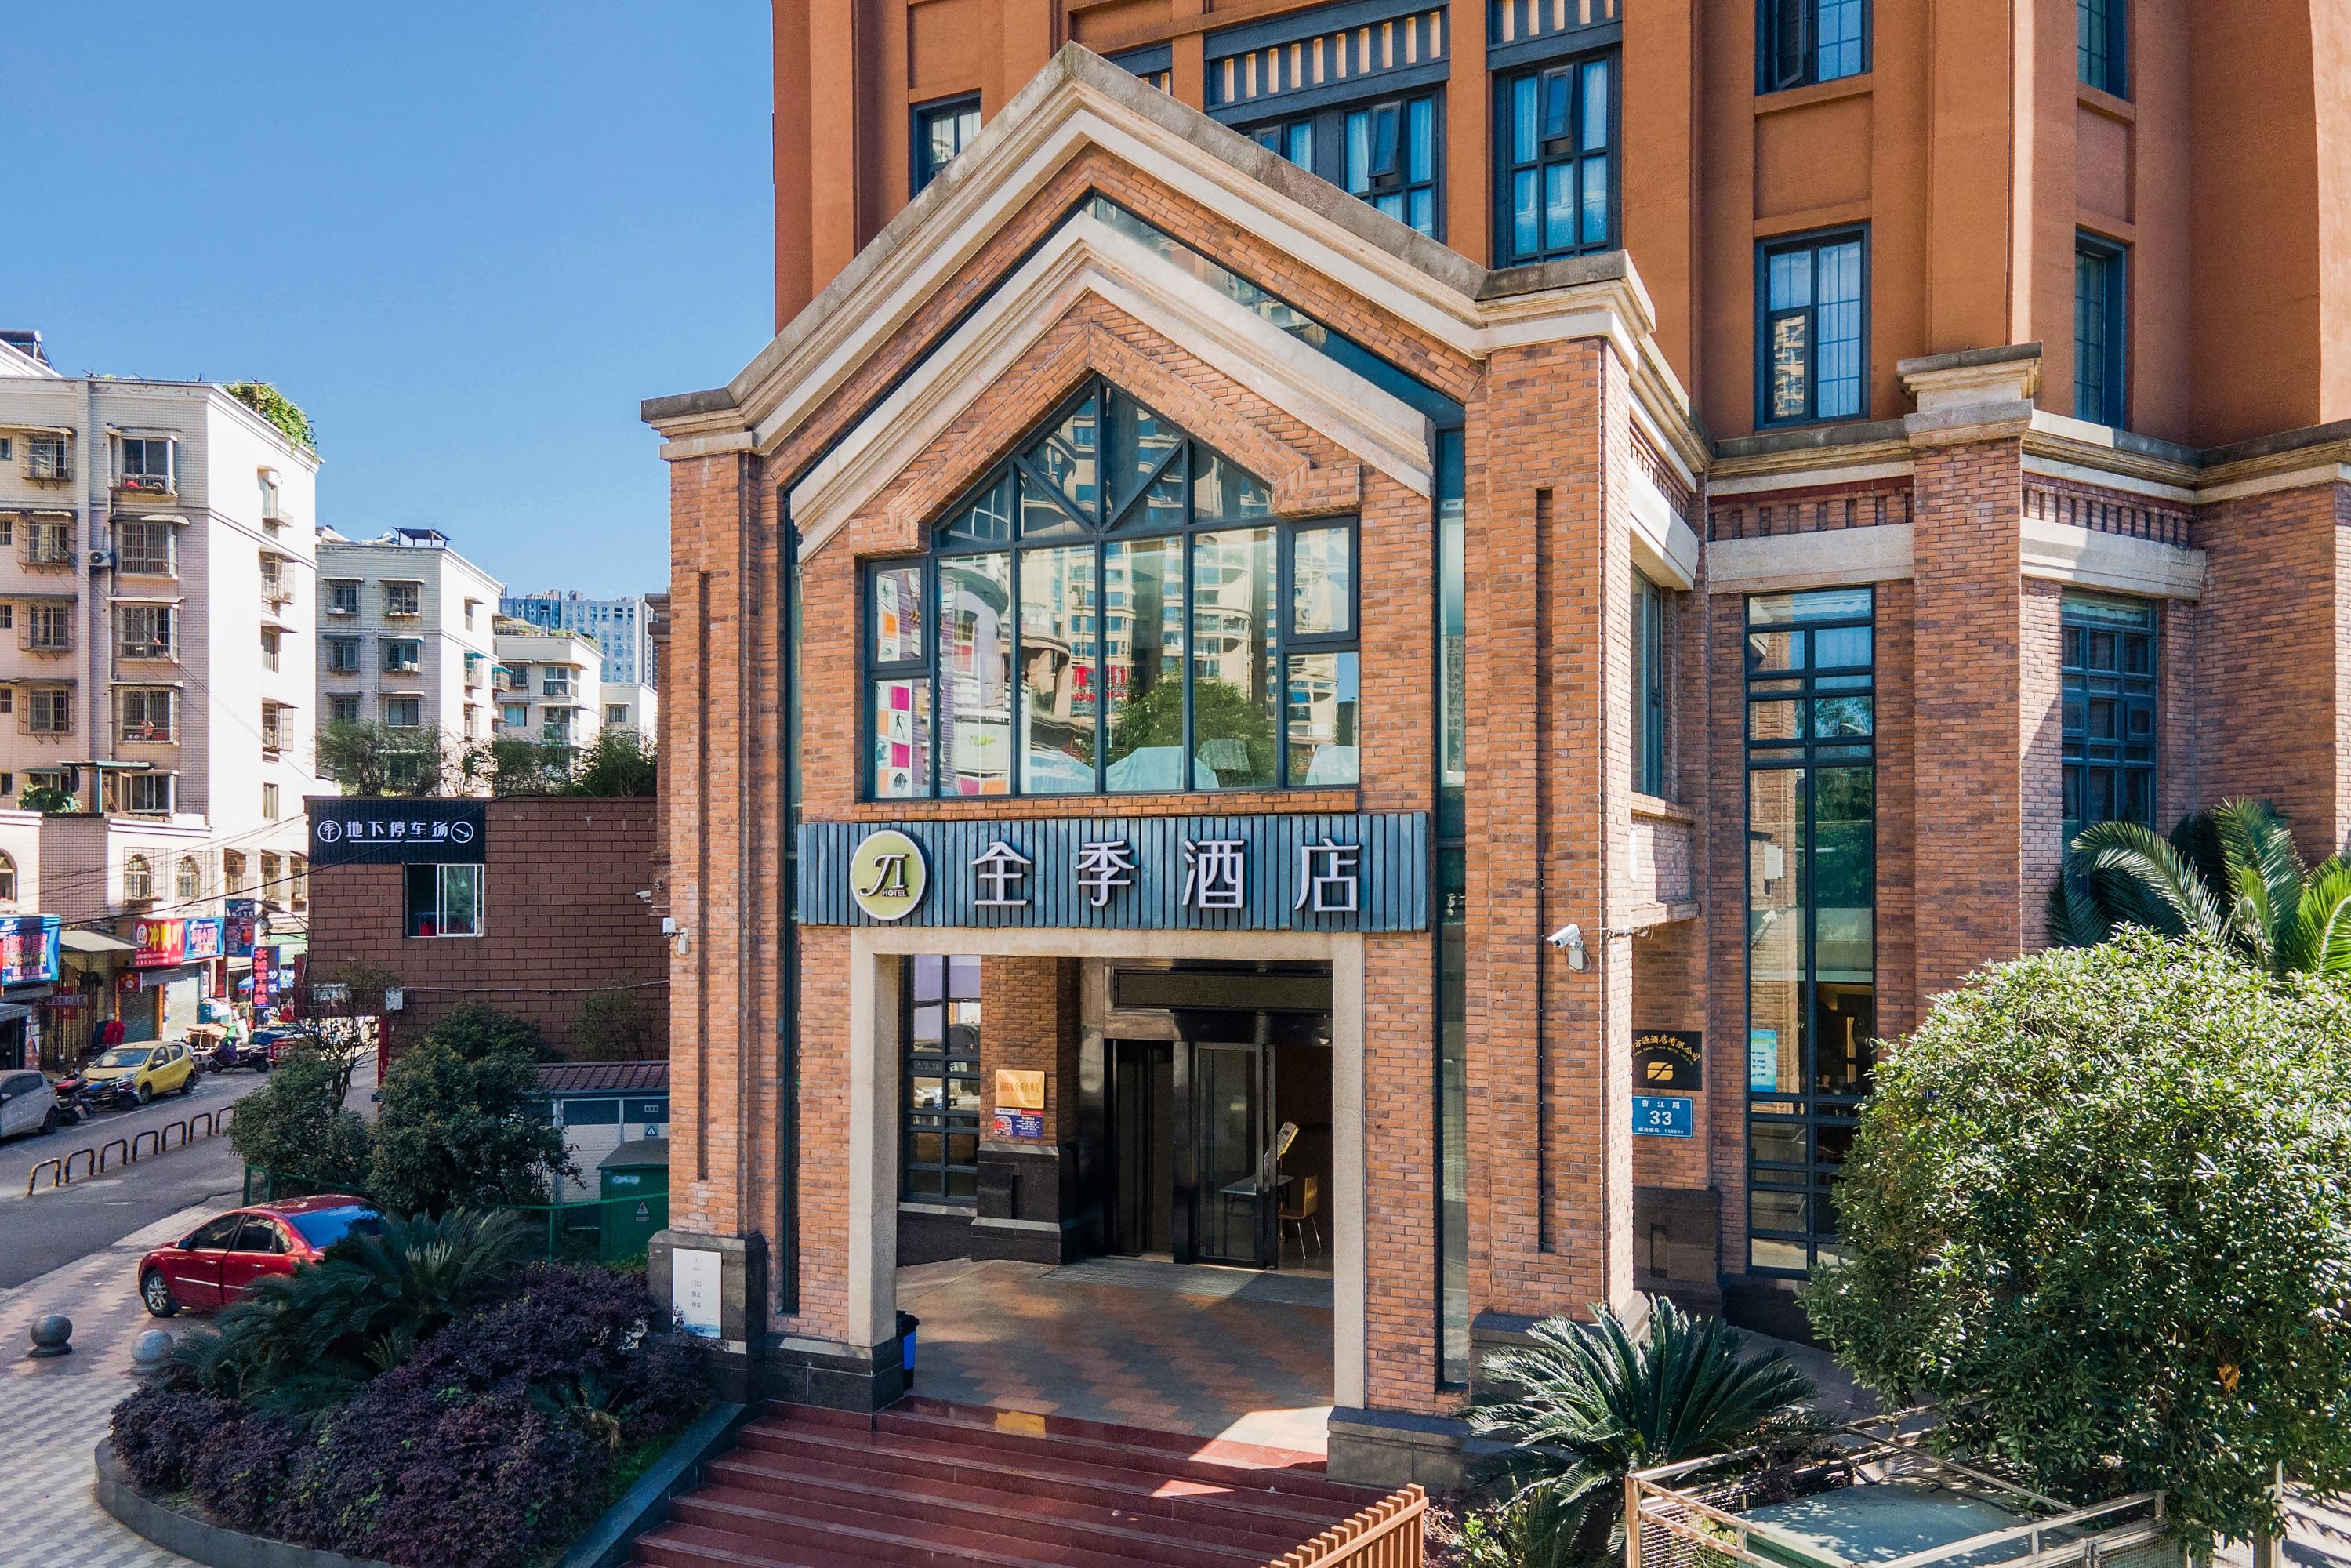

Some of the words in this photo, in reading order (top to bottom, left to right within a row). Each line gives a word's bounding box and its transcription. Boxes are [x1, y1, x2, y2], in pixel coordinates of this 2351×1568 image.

[346, 820, 448, 837] 地下停车场
[972, 837, 1361, 912] 全季酒店
[268, 969, 278, 993] 炒饭
[1649, 1110, 1672, 1126] 33
